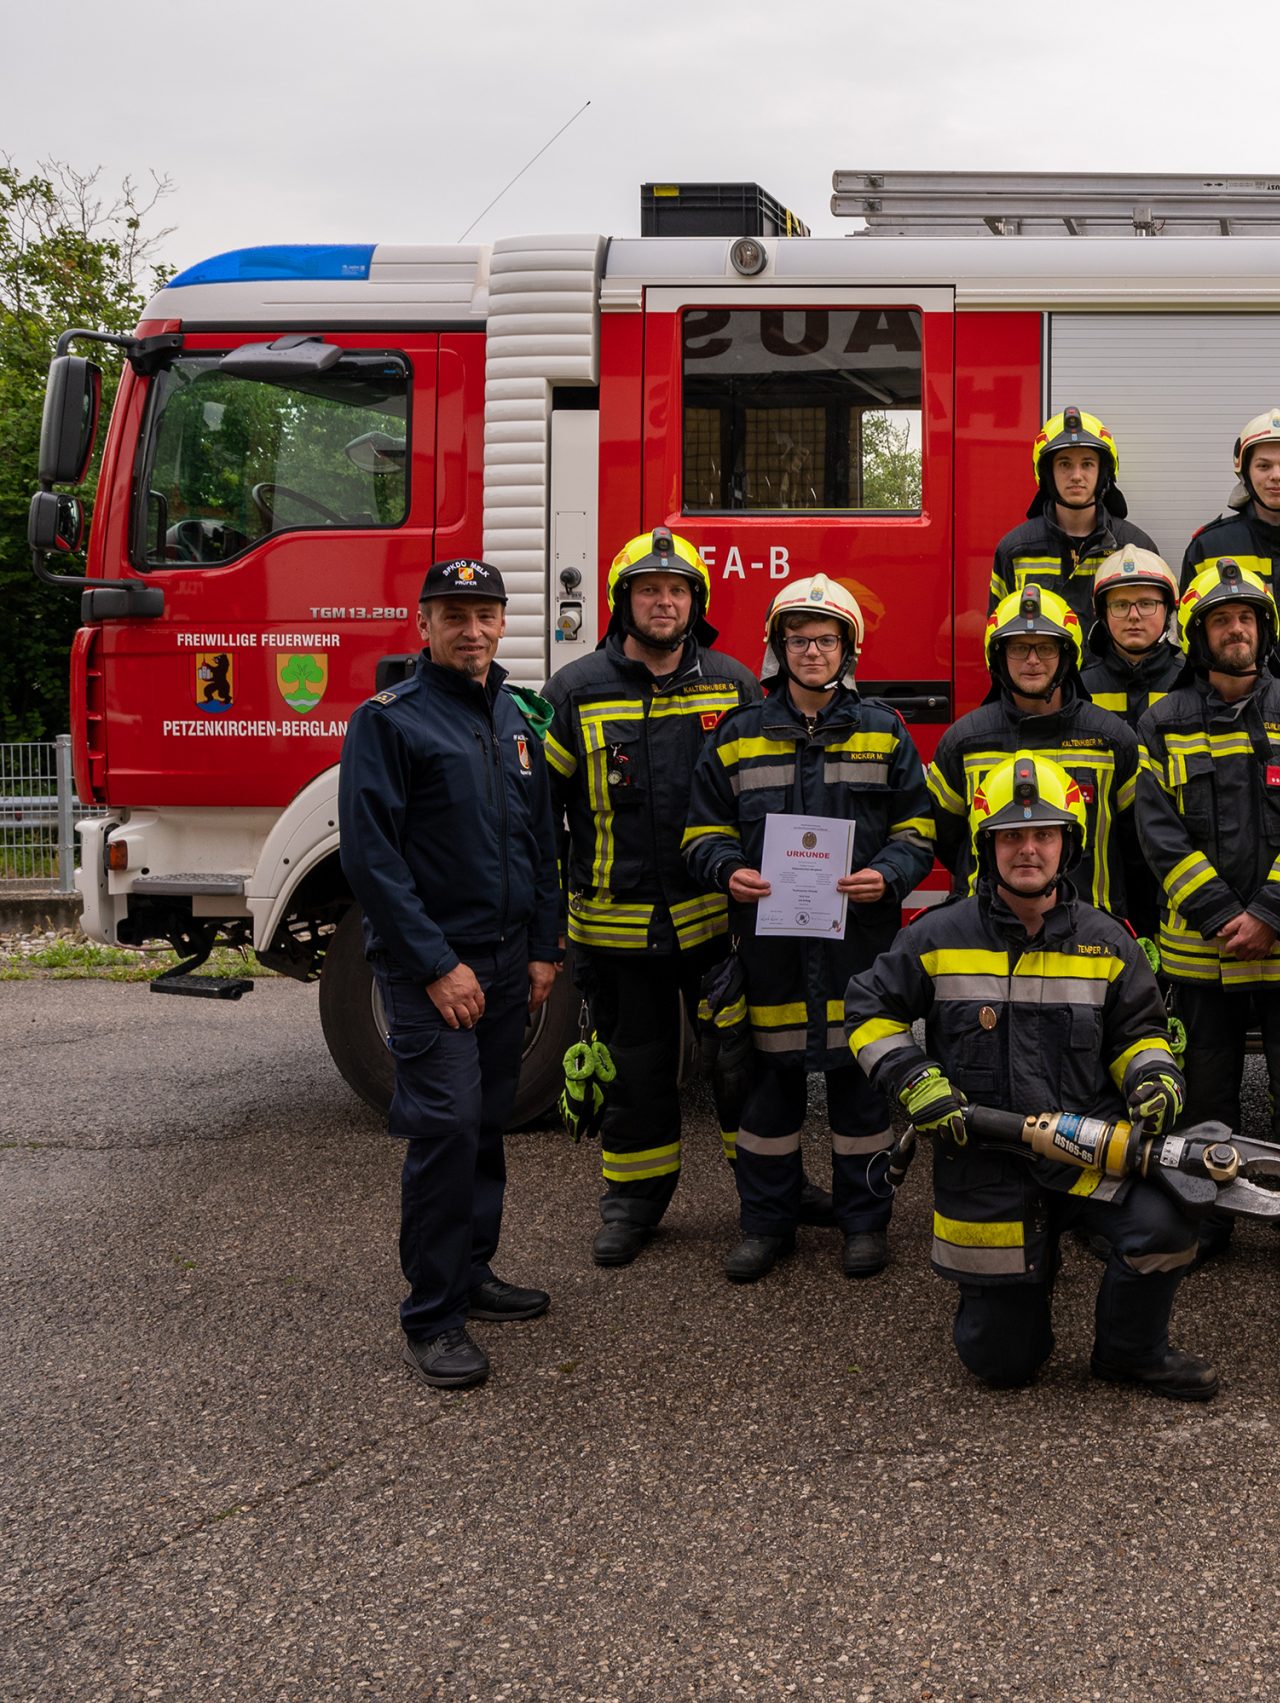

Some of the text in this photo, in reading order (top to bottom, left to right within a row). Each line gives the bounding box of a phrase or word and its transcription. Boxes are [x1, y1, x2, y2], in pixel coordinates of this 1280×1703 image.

[470, 561, 490, 578] MELK
[310, 607, 408, 619] TGM 13.280
[177, 633, 340, 647] FREIWILLIGE FEUERWEHR
[683, 683, 727, 694] KALTENHUBER
[850, 752, 875, 760] KICKER
[786, 850, 831, 860] URKUNDE
[1077, 944, 1101, 954] TEMPER
[1054, 1132, 1094, 1164] RS165-65
